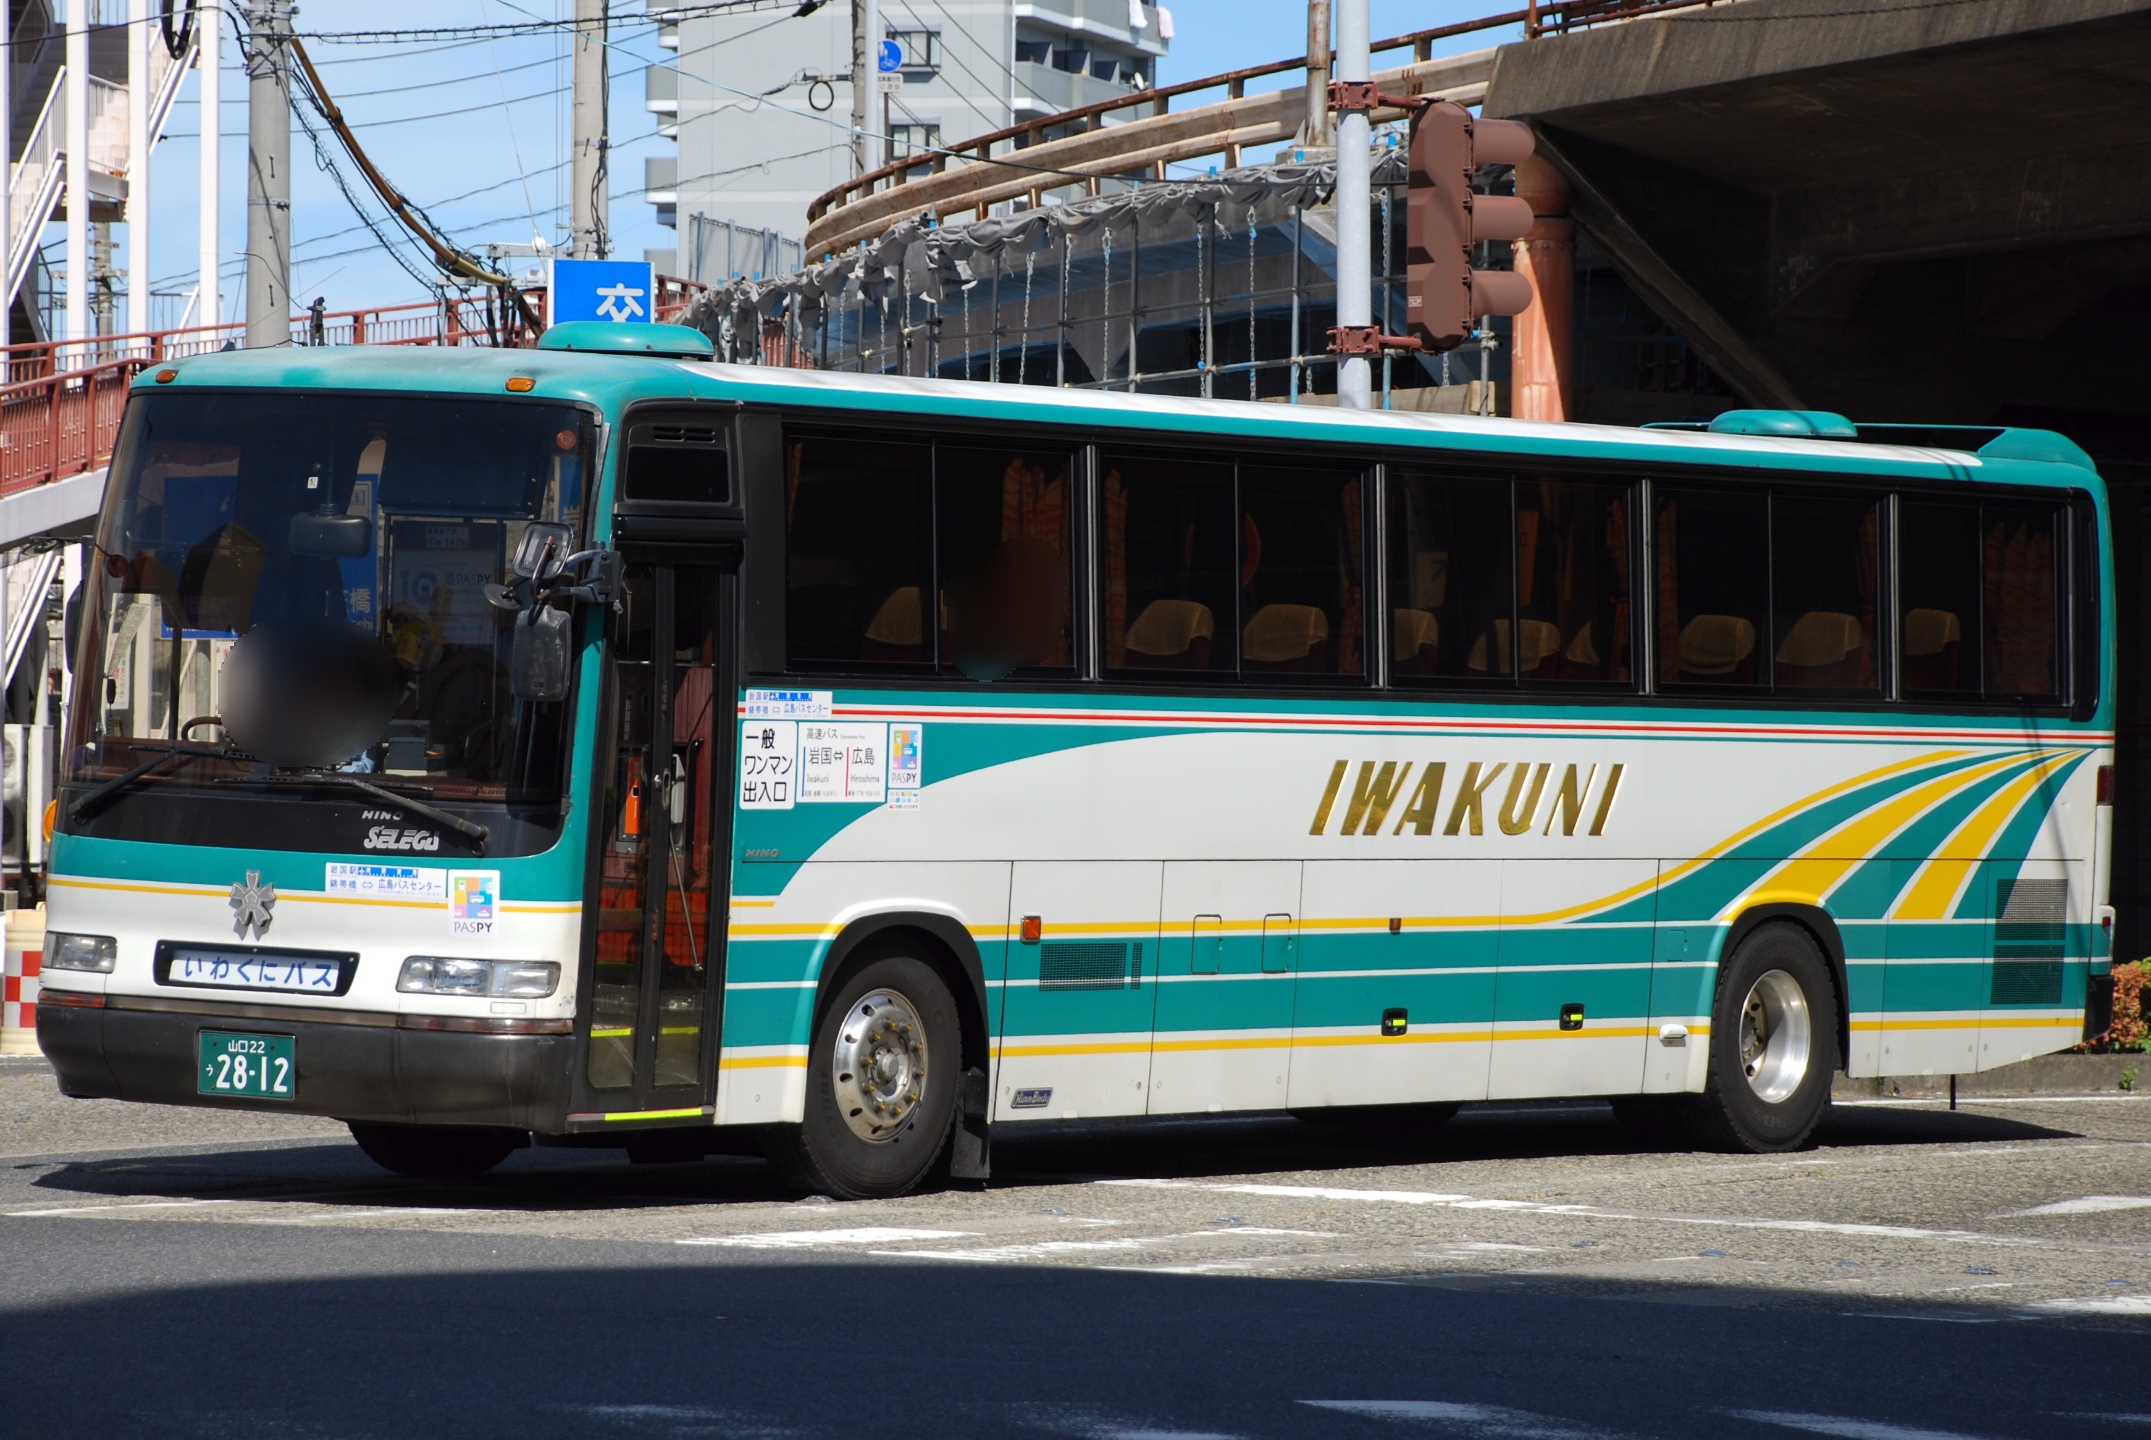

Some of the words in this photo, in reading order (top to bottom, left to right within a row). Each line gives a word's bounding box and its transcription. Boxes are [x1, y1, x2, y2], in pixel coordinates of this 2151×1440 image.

[456, 573, 492, 585] PASPY
[343, 587, 371, 613] 橋
[783, 703, 829, 714] 広島バスセンター
[745, 728, 775, 749] 一般
[806, 727, 838, 740] 高速バス
[808, 746, 832, 765] 岩国
[851, 746, 875, 766] 広島
[744, 755, 793, 775] ワンマン
[806, 773, 830, 783] Iwakuni
[850, 773, 880, 783] Hiroshima
[891, 772, 917, 783] PASPY
[743, 780, 787, 802] 出入口
[1308, 759, 1628, 836] IWAKUNI
[361, 810, 404, 821] HINO
[745, 848, 780, 859] HINO
[330, 865, 357, 875] 岩国駅
[330, 879, 357, 889] 錦帯橋
[378, 878, 442, 892] 広島バスセンター
[454, 921, 493, 933] PASPY
[185, 956, 332, 987] いわくにバス
[215, 1053, 289, 1093] 28-12
